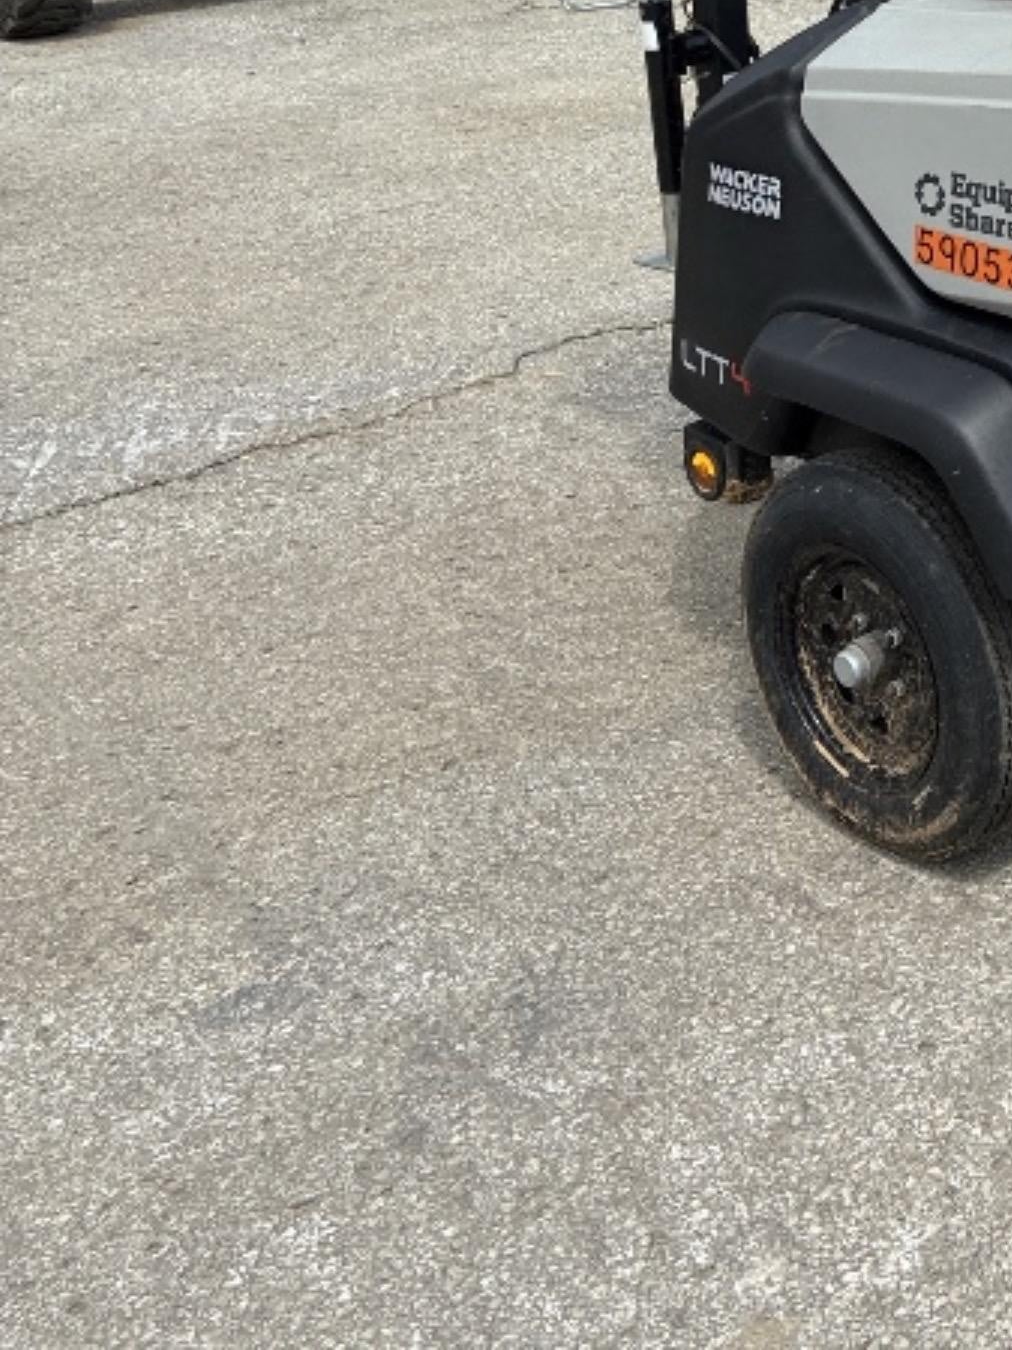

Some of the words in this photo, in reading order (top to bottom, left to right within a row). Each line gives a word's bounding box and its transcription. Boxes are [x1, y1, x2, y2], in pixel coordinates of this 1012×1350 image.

[709, 161, 781, 200] WACKER
[707, 182, 781, 220] NEUSON
[680, 338, 752, 397] LTT4
